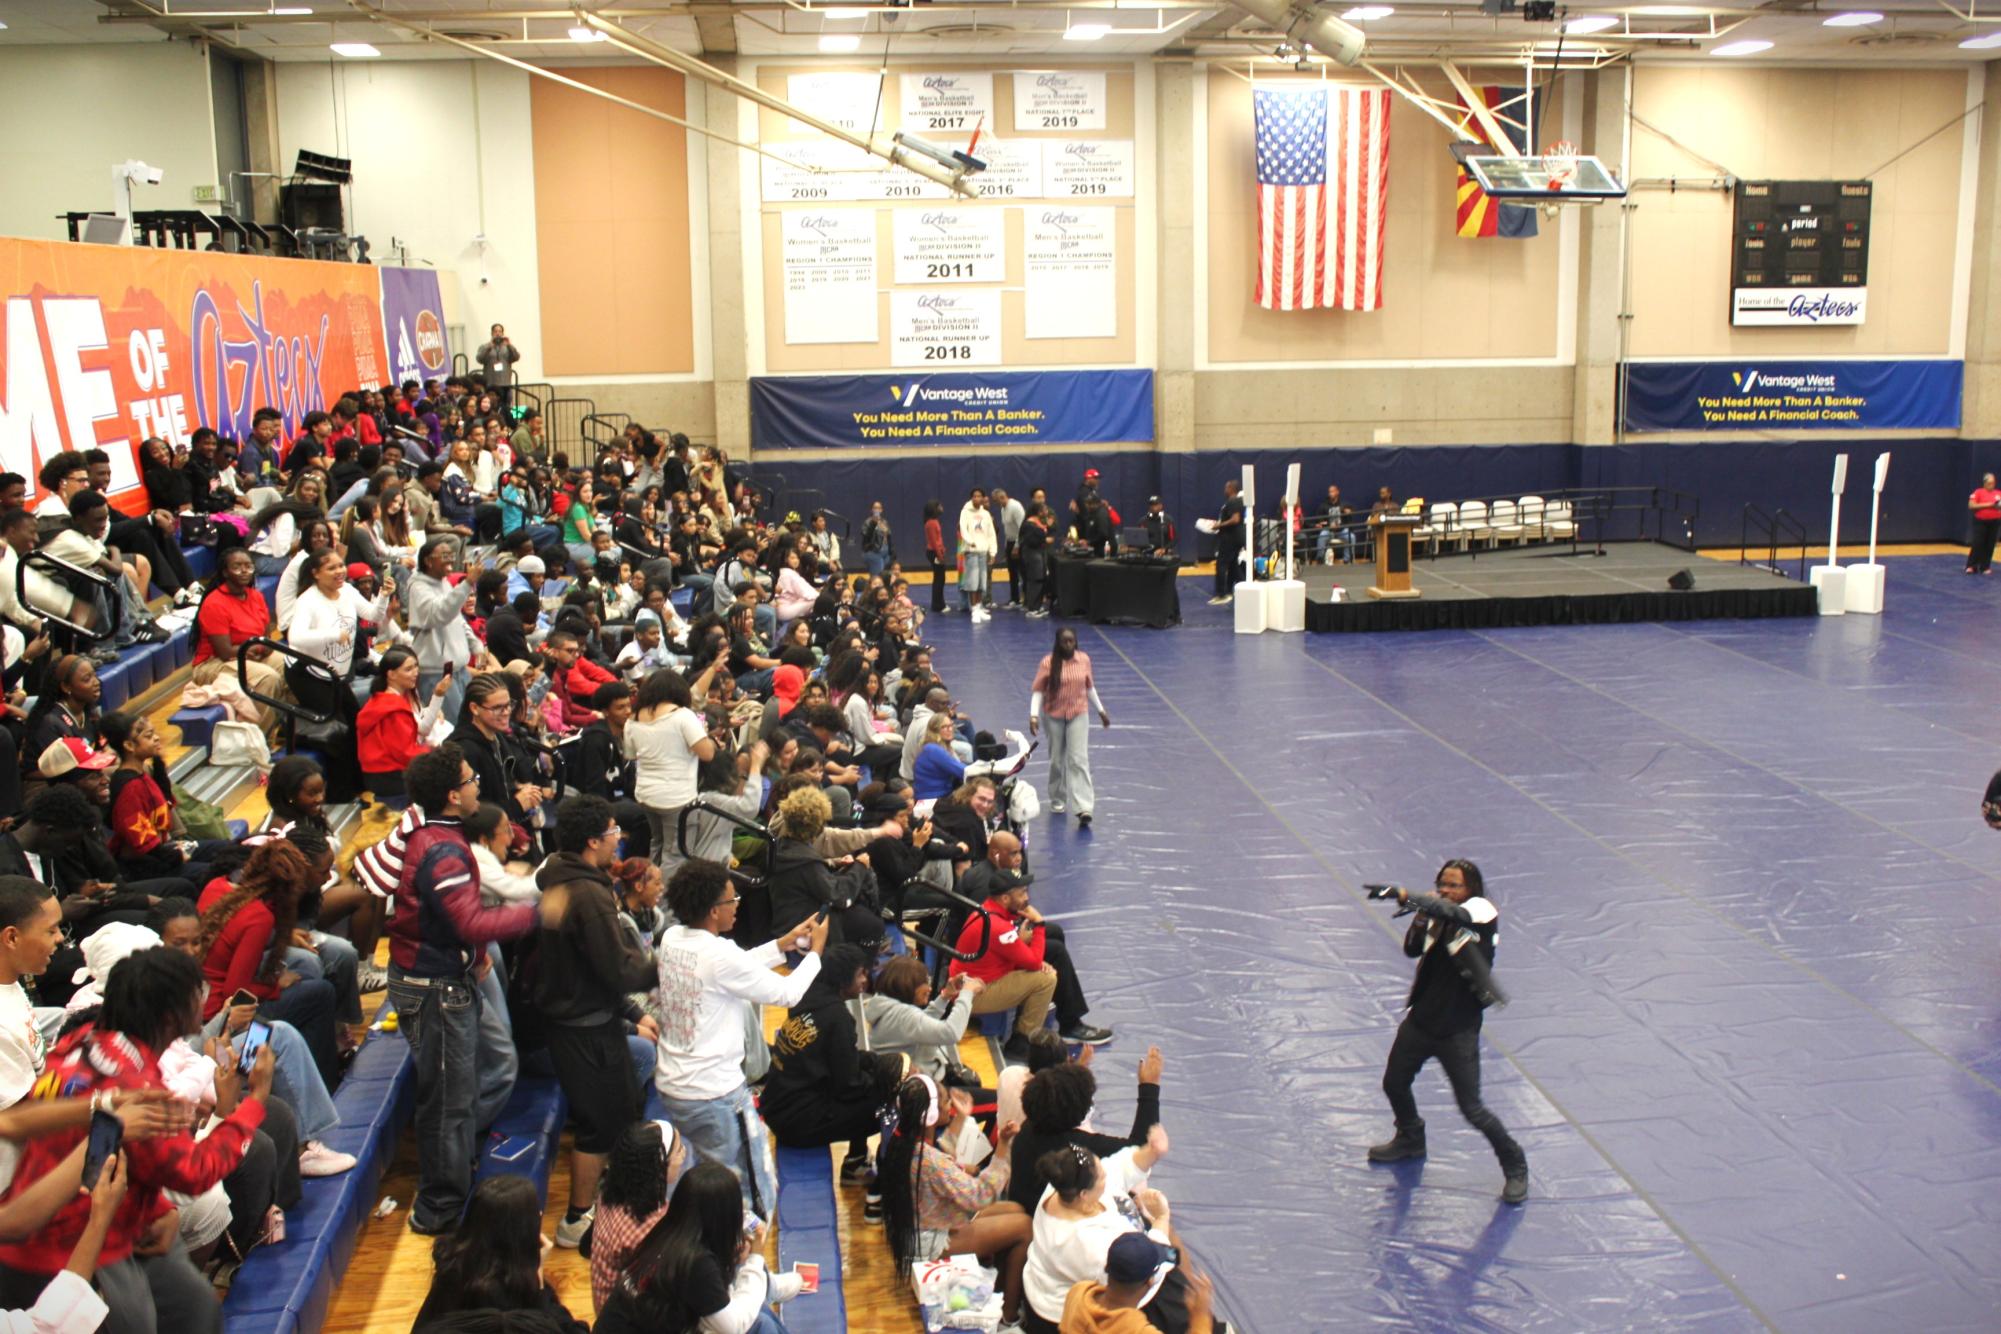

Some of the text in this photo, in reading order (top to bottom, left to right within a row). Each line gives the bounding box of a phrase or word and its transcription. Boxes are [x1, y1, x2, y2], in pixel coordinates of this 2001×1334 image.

[1025, 108, 1056, 116] NATIONAL
[1071, 108, 1095, 116] PLACE
[929, 117, 965, 129] 2017
[1041, 115, 1079, 128] 2019
[791, 187, 828, 198] 2009
[884, 185, 921, 197] 2010
[978, 184, 1014, 196] 2016
[1070, 183, 1107, 195] 2019
[1791, 216, 1818, 231] period
[1790, 236, 1817, 249] player
[785, 256, 817, 264] REGION
[825, 255, 873, 263] CHAMPIONS
[903, 253, 944, 261] NATIONAL
[946, 252, 982, 260] RUNNER
[1066, 251, 1113, 259] CHAMPIONS
[926, 262, 975, 278] 2011
[1738, 296, 1762, 306] Home
[1763, 295, 1772, 306] of
[1772, 295, 1786, 305] the
[937, 315, 980, 325] Basketball
[899, 335, 940, 343] NATIONAL
[942, 334, 977, 342] RUNNER
[924, 345, 972, 361] 2018
[129, 328, 171, 393] OF
[1757, 374, 1836, 388] Vantage West
[919, 386, 1008, 402] Vantage West
[1698, 396, 1867, 408] You Need More Than A Banker.
[853, 407, 1046, 424] You Need More Than A Banker.
[1703, 408, 1861, 422] You Need A Financial Coach.
[130, 394, 193, 452] THE
[860, 422, 1039, 438] You Need A Financial Coach.
